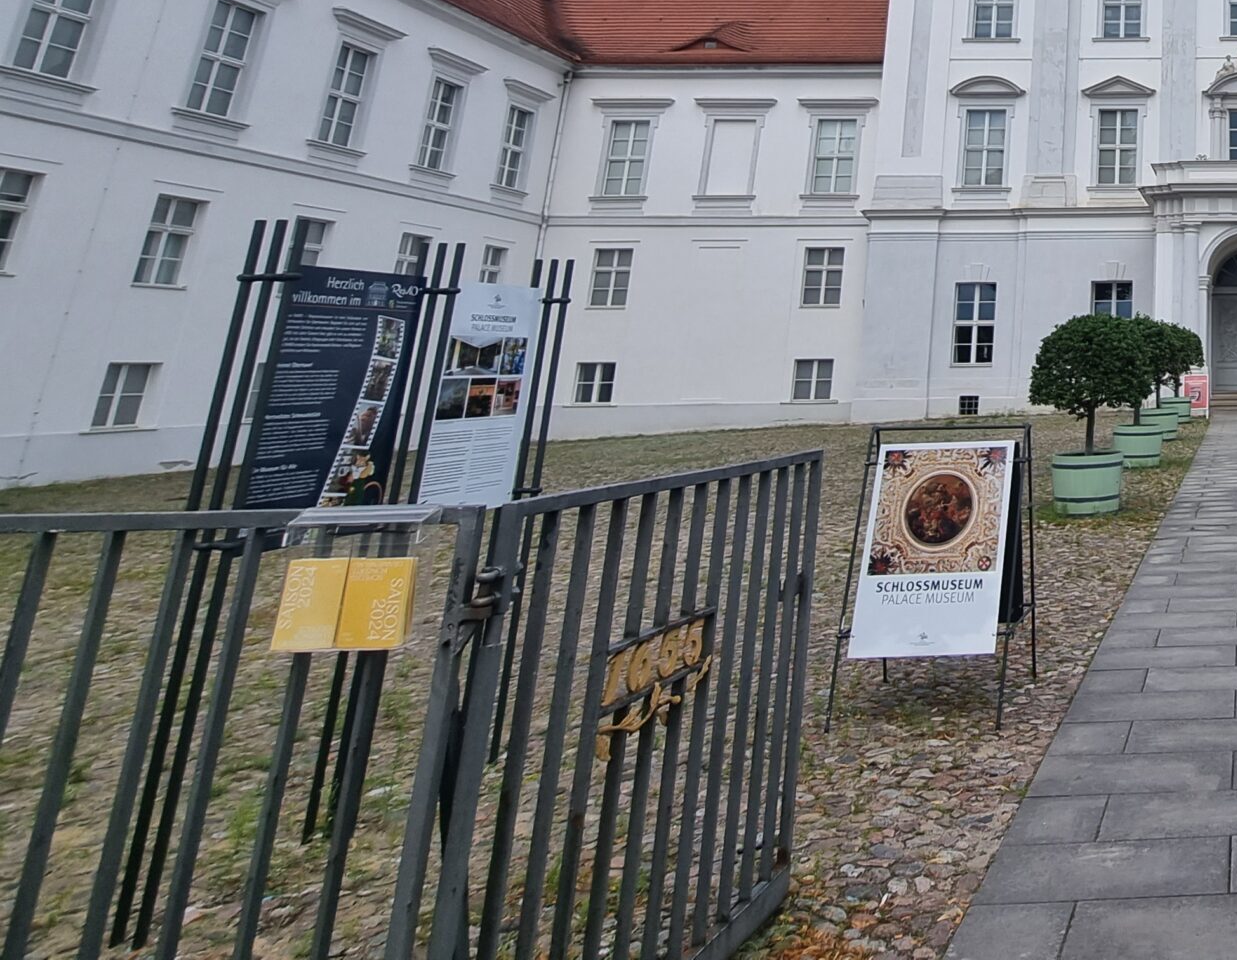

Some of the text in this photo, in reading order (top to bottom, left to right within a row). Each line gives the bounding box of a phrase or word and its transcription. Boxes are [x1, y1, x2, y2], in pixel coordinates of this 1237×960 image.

[327, 276, 365, 290] Herzlich
[349, 294, 362, 306] im
[471, 313, 517, 324] SCHLOSSMUSEUM
[471, 323, 514, 332] PALACE MUSEUM
[298, 565, 318, 609] 2024
[875, 578, 983, 593] SCHLOSSMUSEUM
[278, 565, 302, 630] SAISON
[881, 592, 975, 605] PALACE MUSEUM
[382, 577, 404, 641] SAISON
[367, 599, 385, 641] 2024
